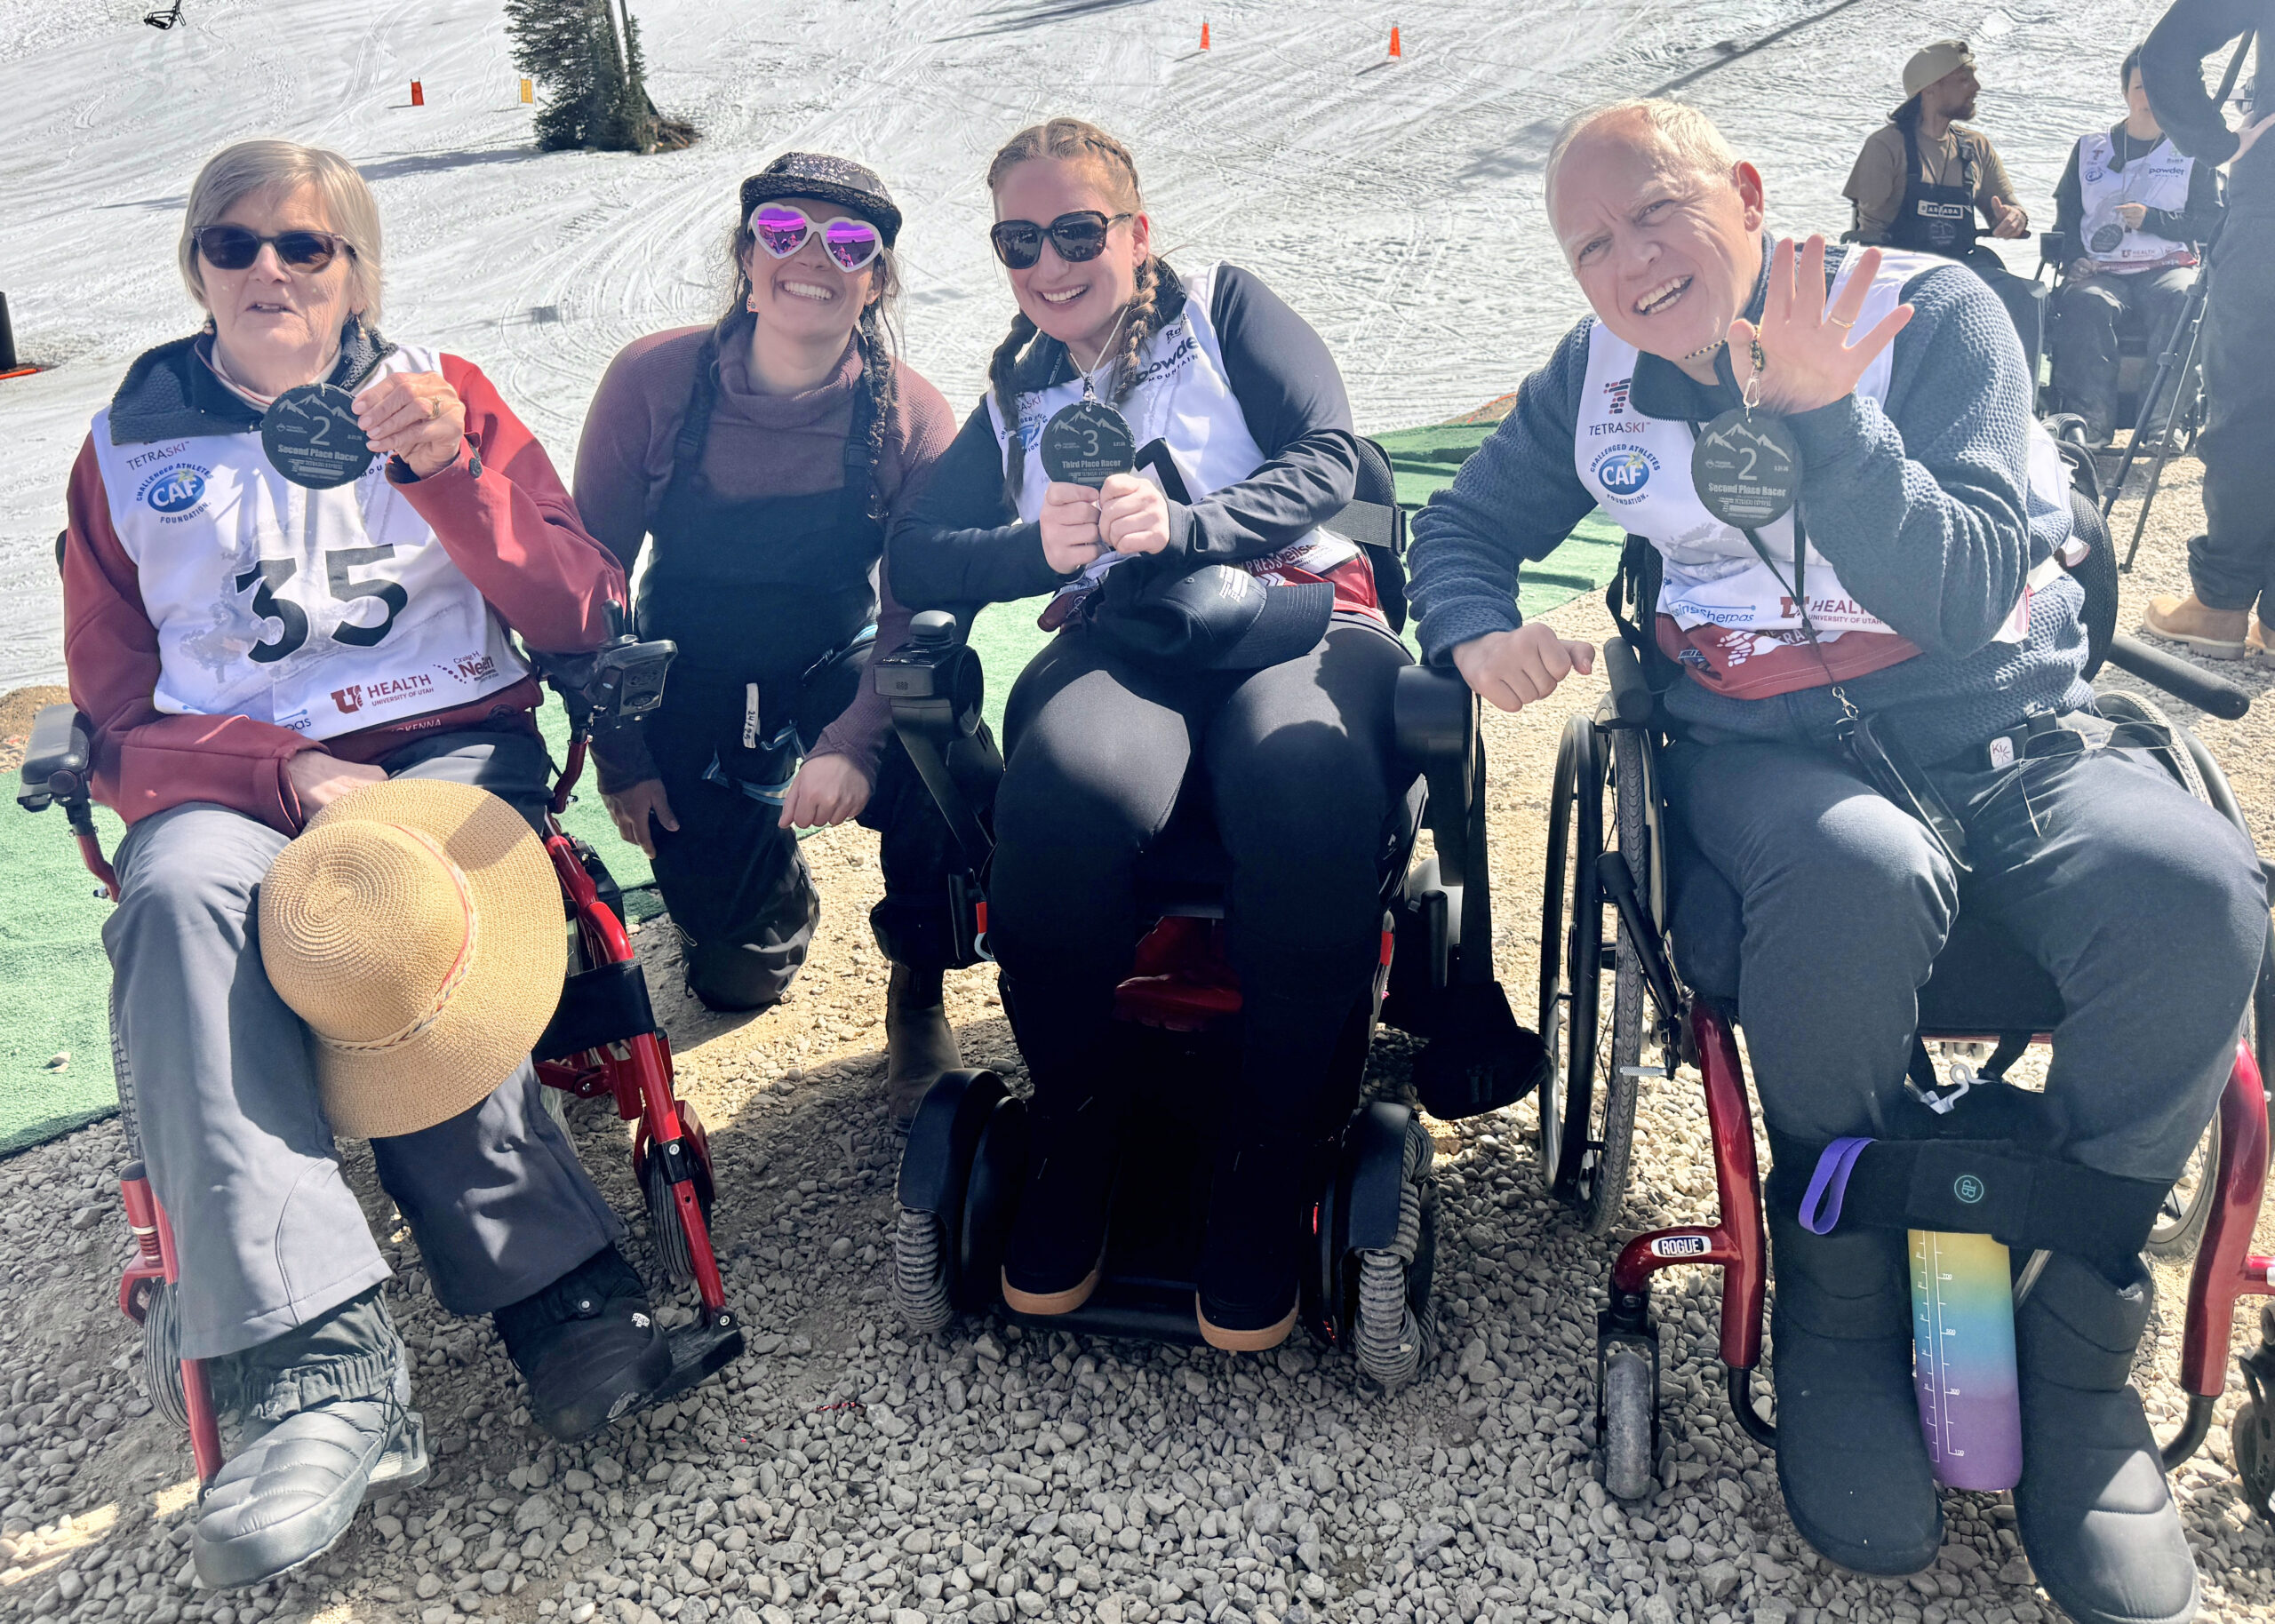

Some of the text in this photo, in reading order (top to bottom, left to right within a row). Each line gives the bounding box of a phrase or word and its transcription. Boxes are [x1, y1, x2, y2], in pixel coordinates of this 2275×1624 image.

[1136, 337, 1198, 386] powde
[1148, 354, 1199, 382] MOUNTAIN
[310, 416, 331, 446] 2
[1082, 429, 1099, 457] 3
[277, 444, 359, 462] Second Place Racer
[1590, 443, 1661, 473] CHALLENGED ATHLETES
[1738, 447, 1758, 481] 2
[136, 463, 214, 502] CHALLENGED ATHLETES
[1601, 465, 1644, 486] CAF
[153, 477, 197, 507] CAF
[1607, 493, 1647, 506] FOUNDATION
[1708, 482, 1786, 498] Second Place Racer
[160, 501, 210, 524] FOUNDATION
[235, 543, 409, 664] 35
[1811, 600, 1864, 615] HEAL
[1808, 614, 1848, 623] UNIVERSITY
[367, 674, 432, 698] HEALTH
[371, 693, 407, 706] UNIVERSITY
[418, 687, 435, 696] UTAH
[1661, 1238, 1701, 1255] ROGUE
